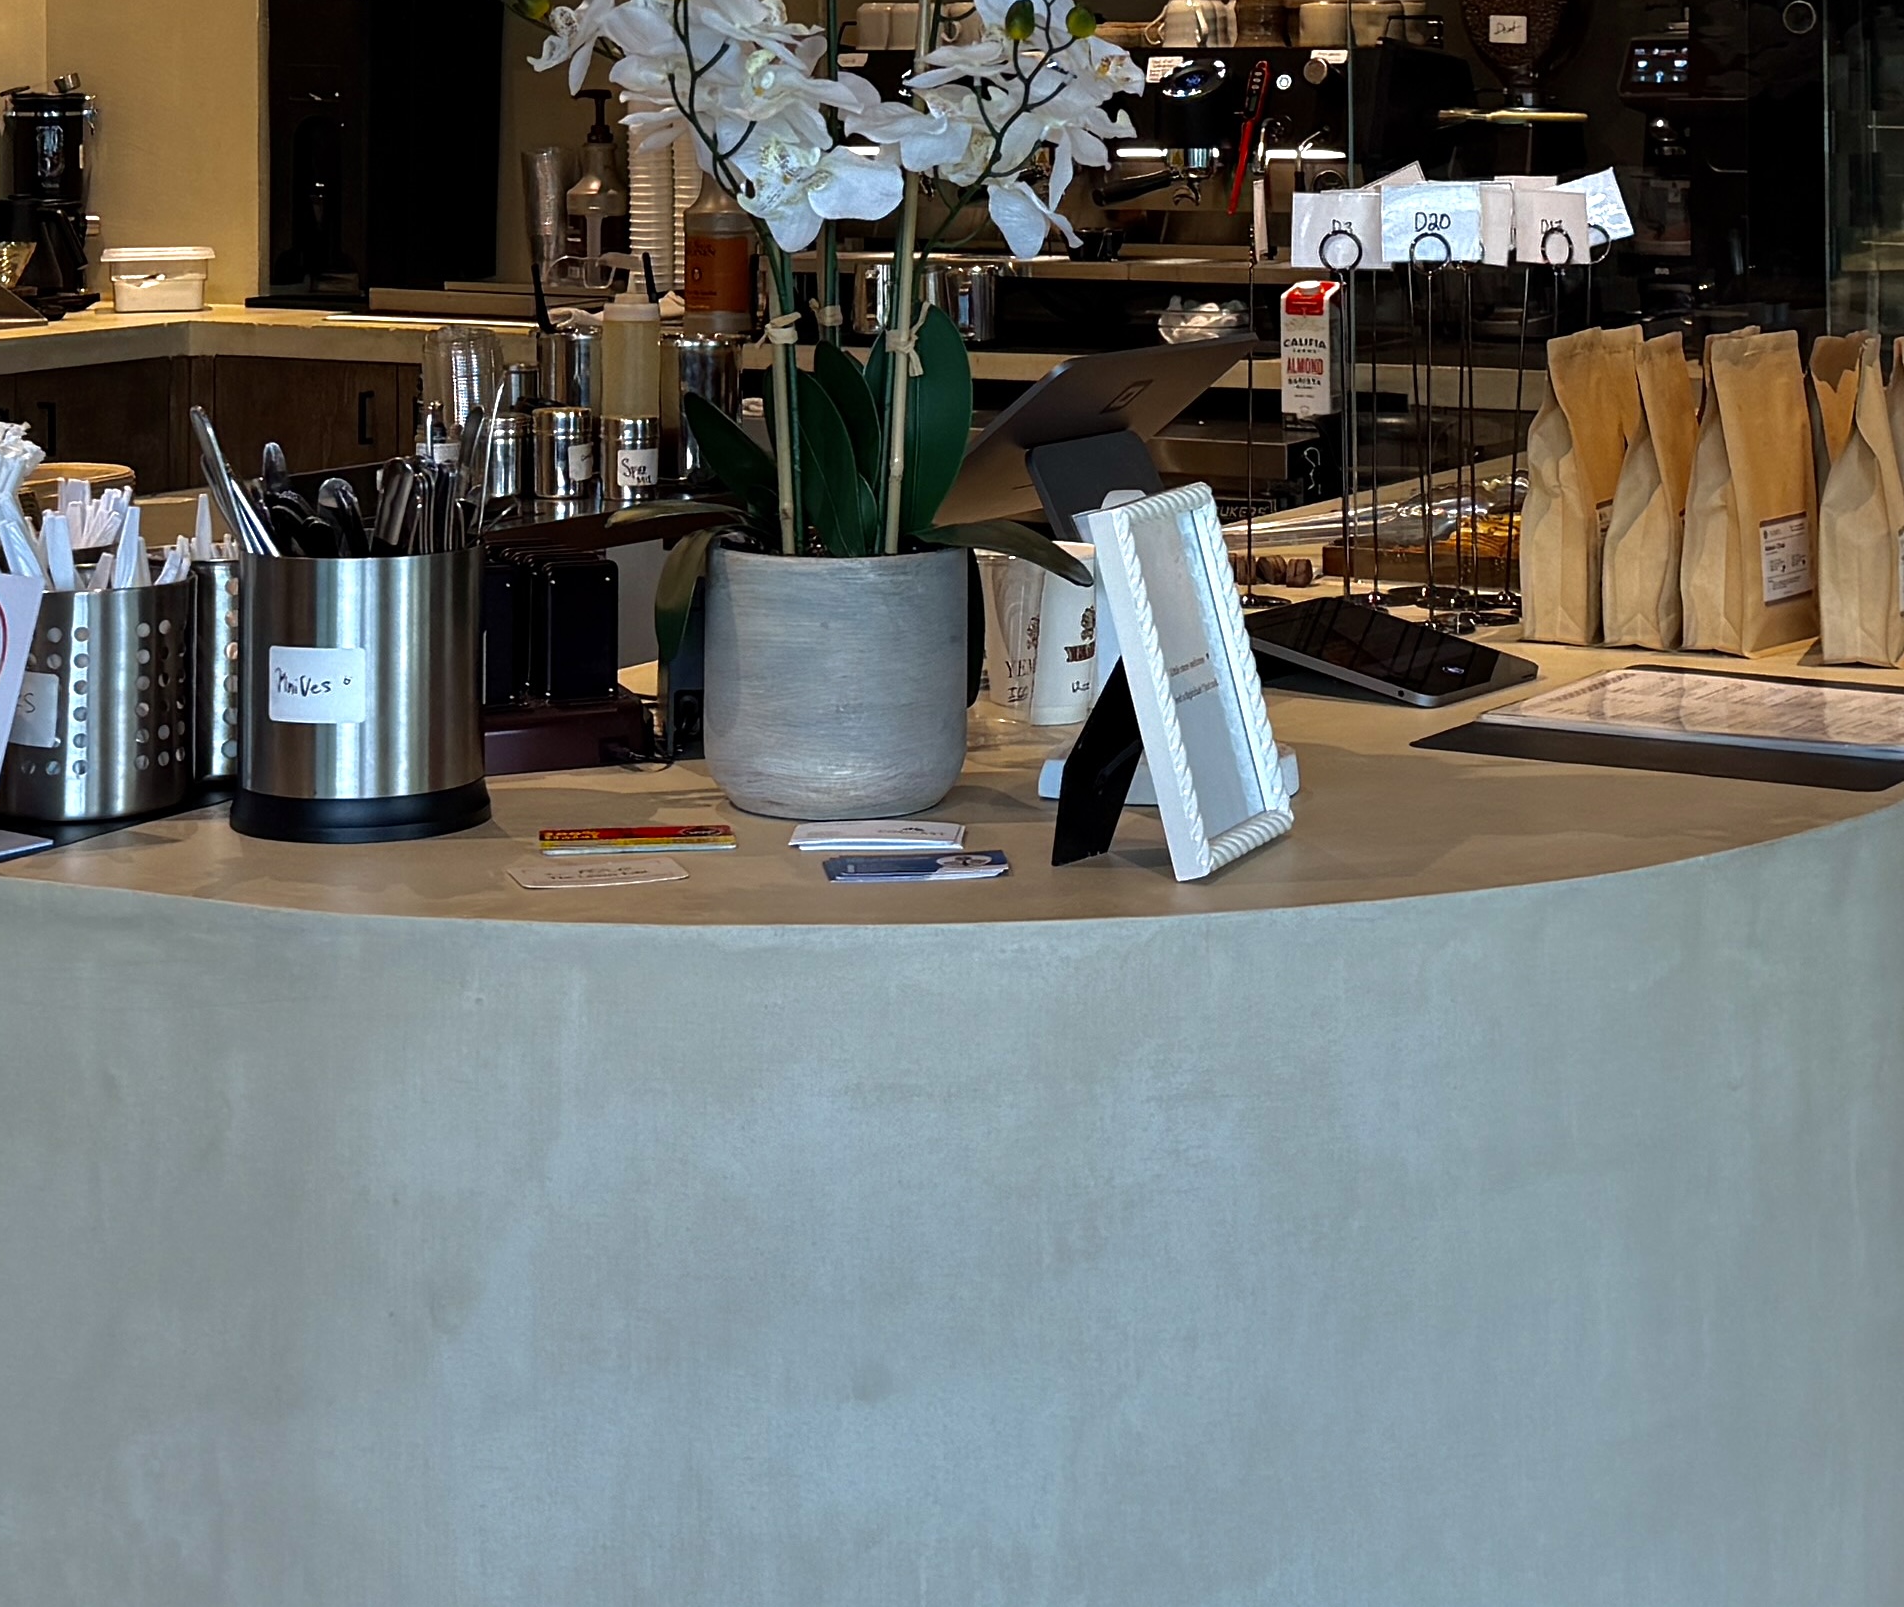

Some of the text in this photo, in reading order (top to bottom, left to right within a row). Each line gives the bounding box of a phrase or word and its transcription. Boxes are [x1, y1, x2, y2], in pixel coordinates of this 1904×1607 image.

[1415, 211, 1451, 232] D20
[1283, 338, 1327, 349] CALIFIA
[1287, 357, 1324, 375] ALMOND
